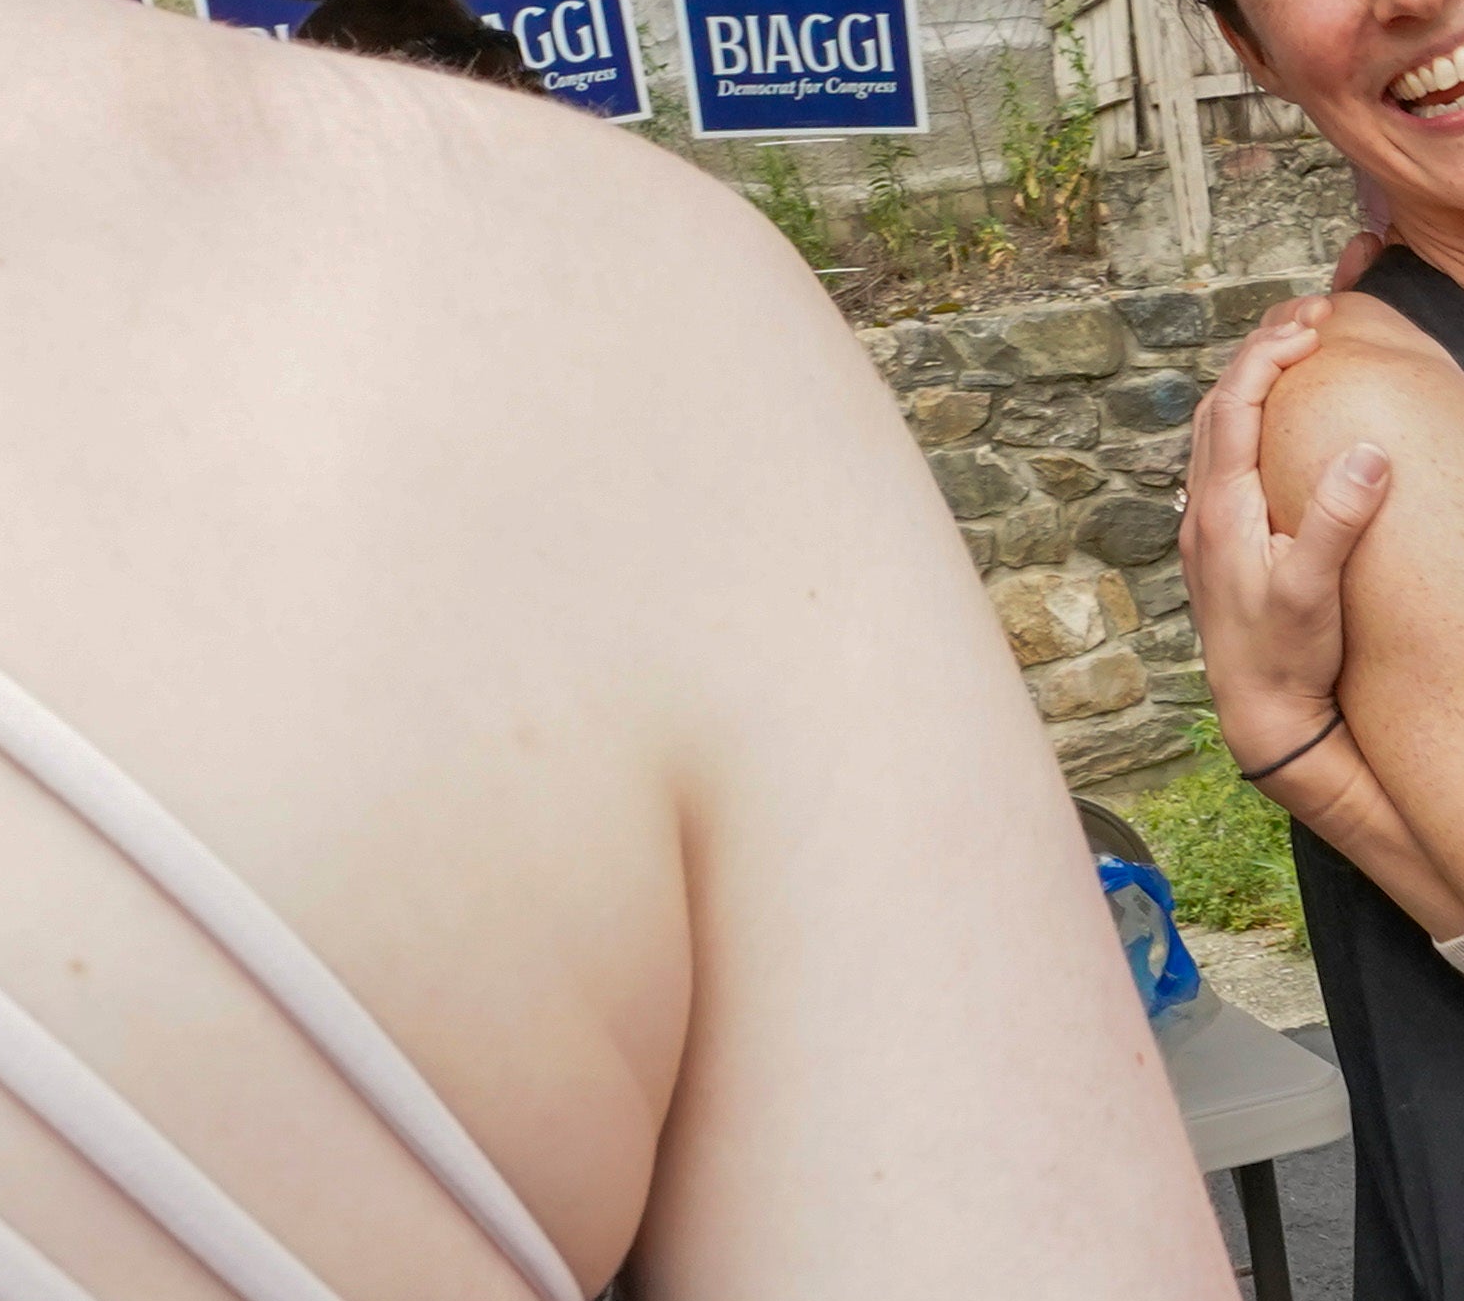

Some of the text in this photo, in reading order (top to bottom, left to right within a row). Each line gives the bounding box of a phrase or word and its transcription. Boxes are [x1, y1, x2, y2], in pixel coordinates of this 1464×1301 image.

[705, 12, 896, 76] BIAGGI
[543, 66, 617, 91] Congress
[717, 76, 898, 101] Democrat for Congress
